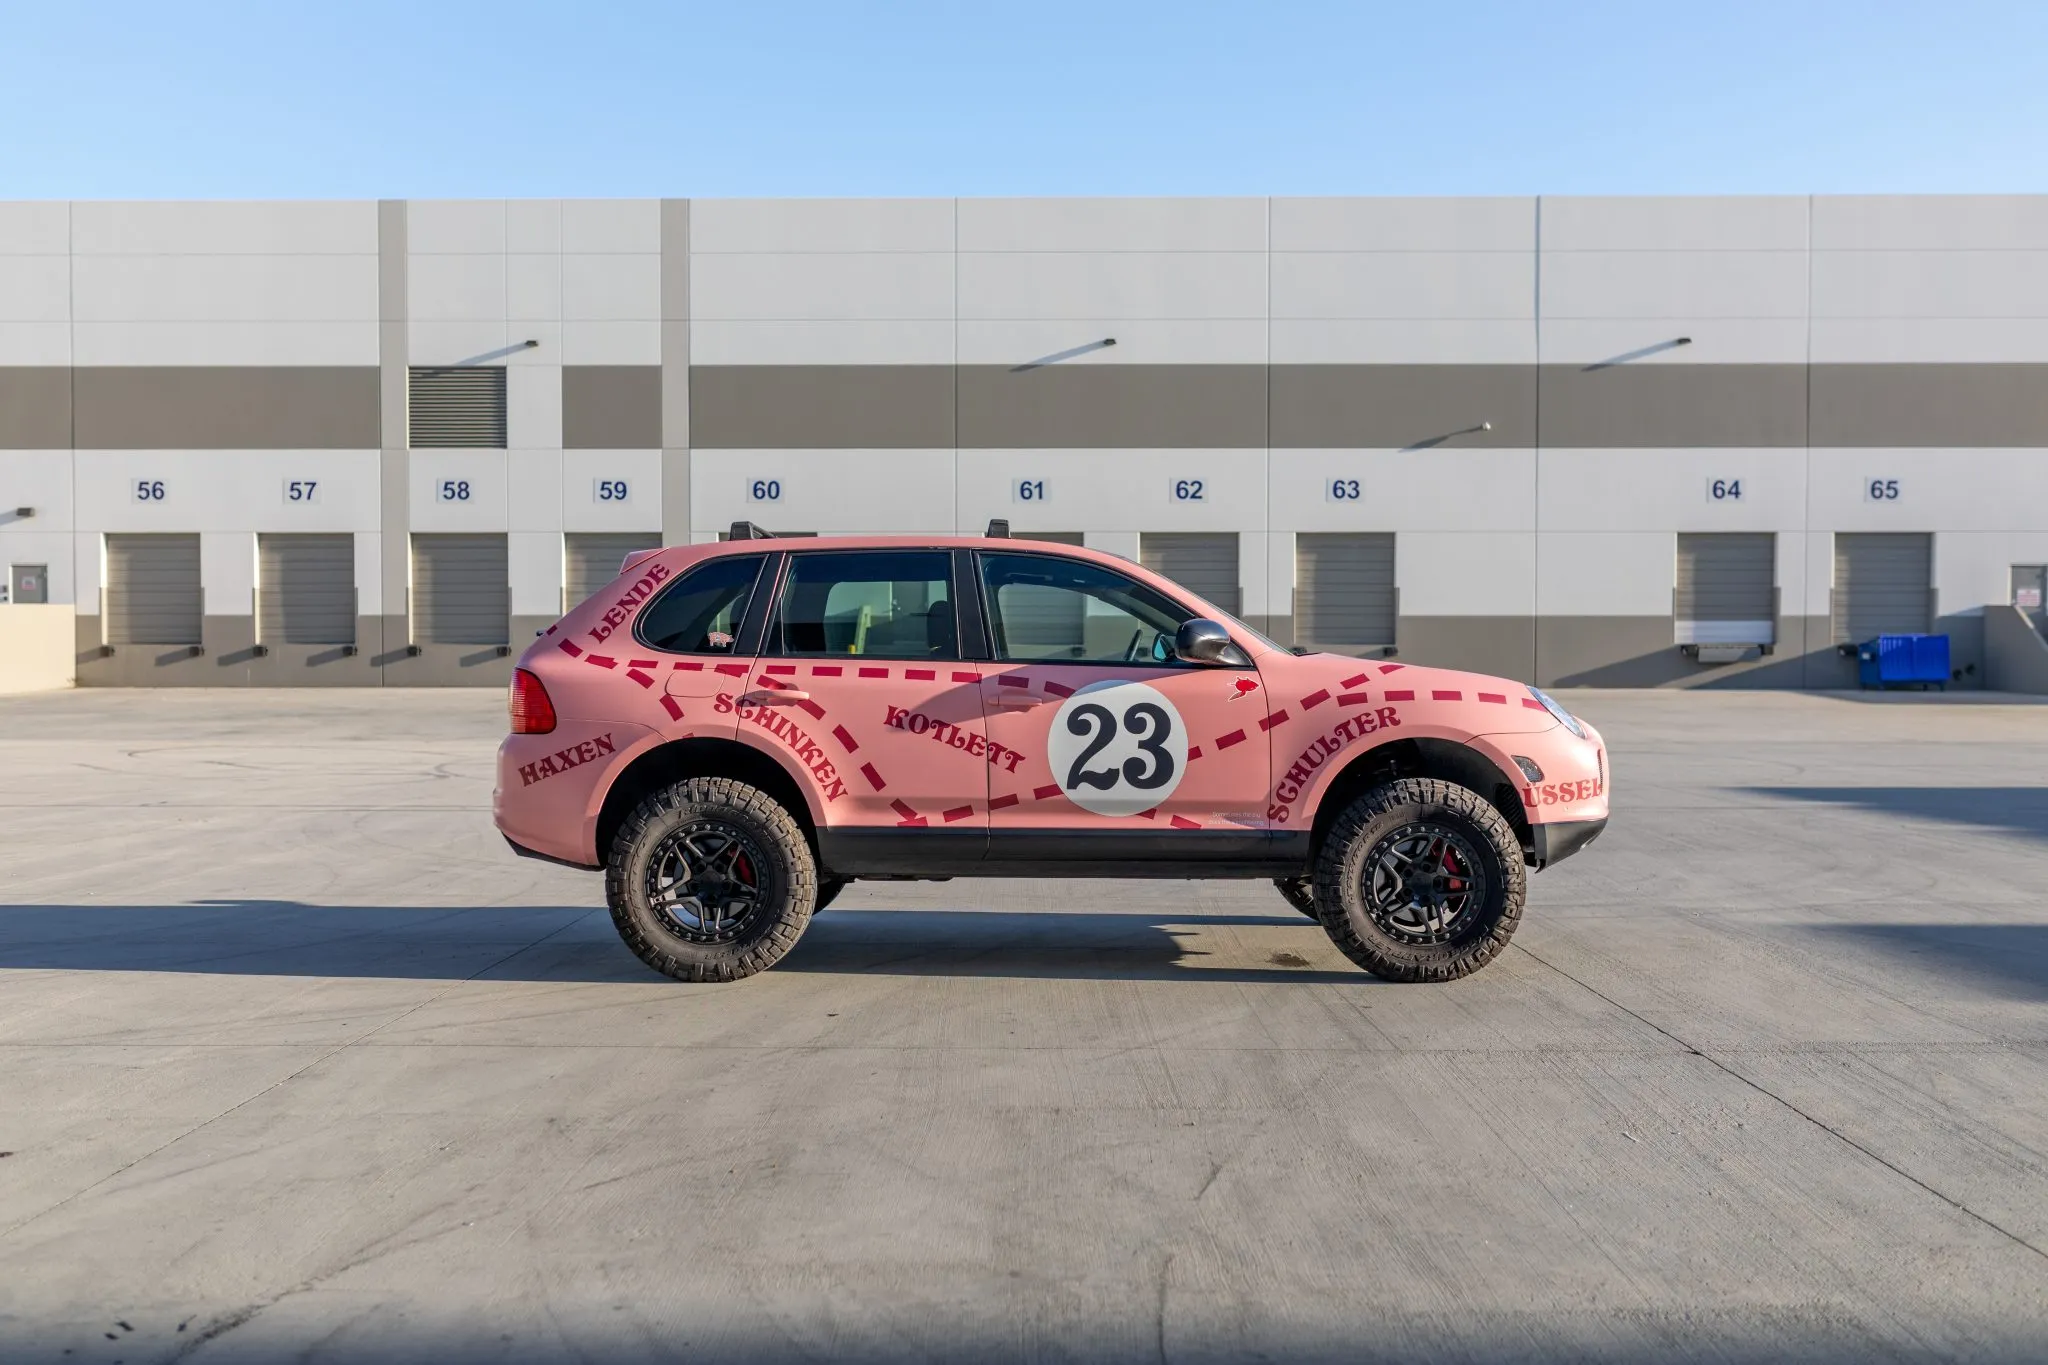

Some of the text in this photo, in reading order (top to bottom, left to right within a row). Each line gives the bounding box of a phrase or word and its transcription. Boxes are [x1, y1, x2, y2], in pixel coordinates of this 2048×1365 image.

[137, 481, 165, 501] 56
[289, 481, 317, 501] 57
[442, 480, 471, 501] 58
[599, 480, 628, 501] 59
[752, 480, 781, 501] 60
[1019, 480, 1044, 501] 61
[1175, 479, 1204, 500] 62
[1332, 479, 1361, 500] 63
[1712, 479, 1742, 500] 64
[1870, 479, 1899, 500] 65
[588, 564, 670, 644] LENDE
[713, 693, 848, 802] SCHINKEN
[883, 705, 1026, 774] KOTLETT
[1067, 702, 1175, 791] 23
[518, 733, 616, 787] HAXEN
[1267, 706, 1401, 823] SCHULTER
